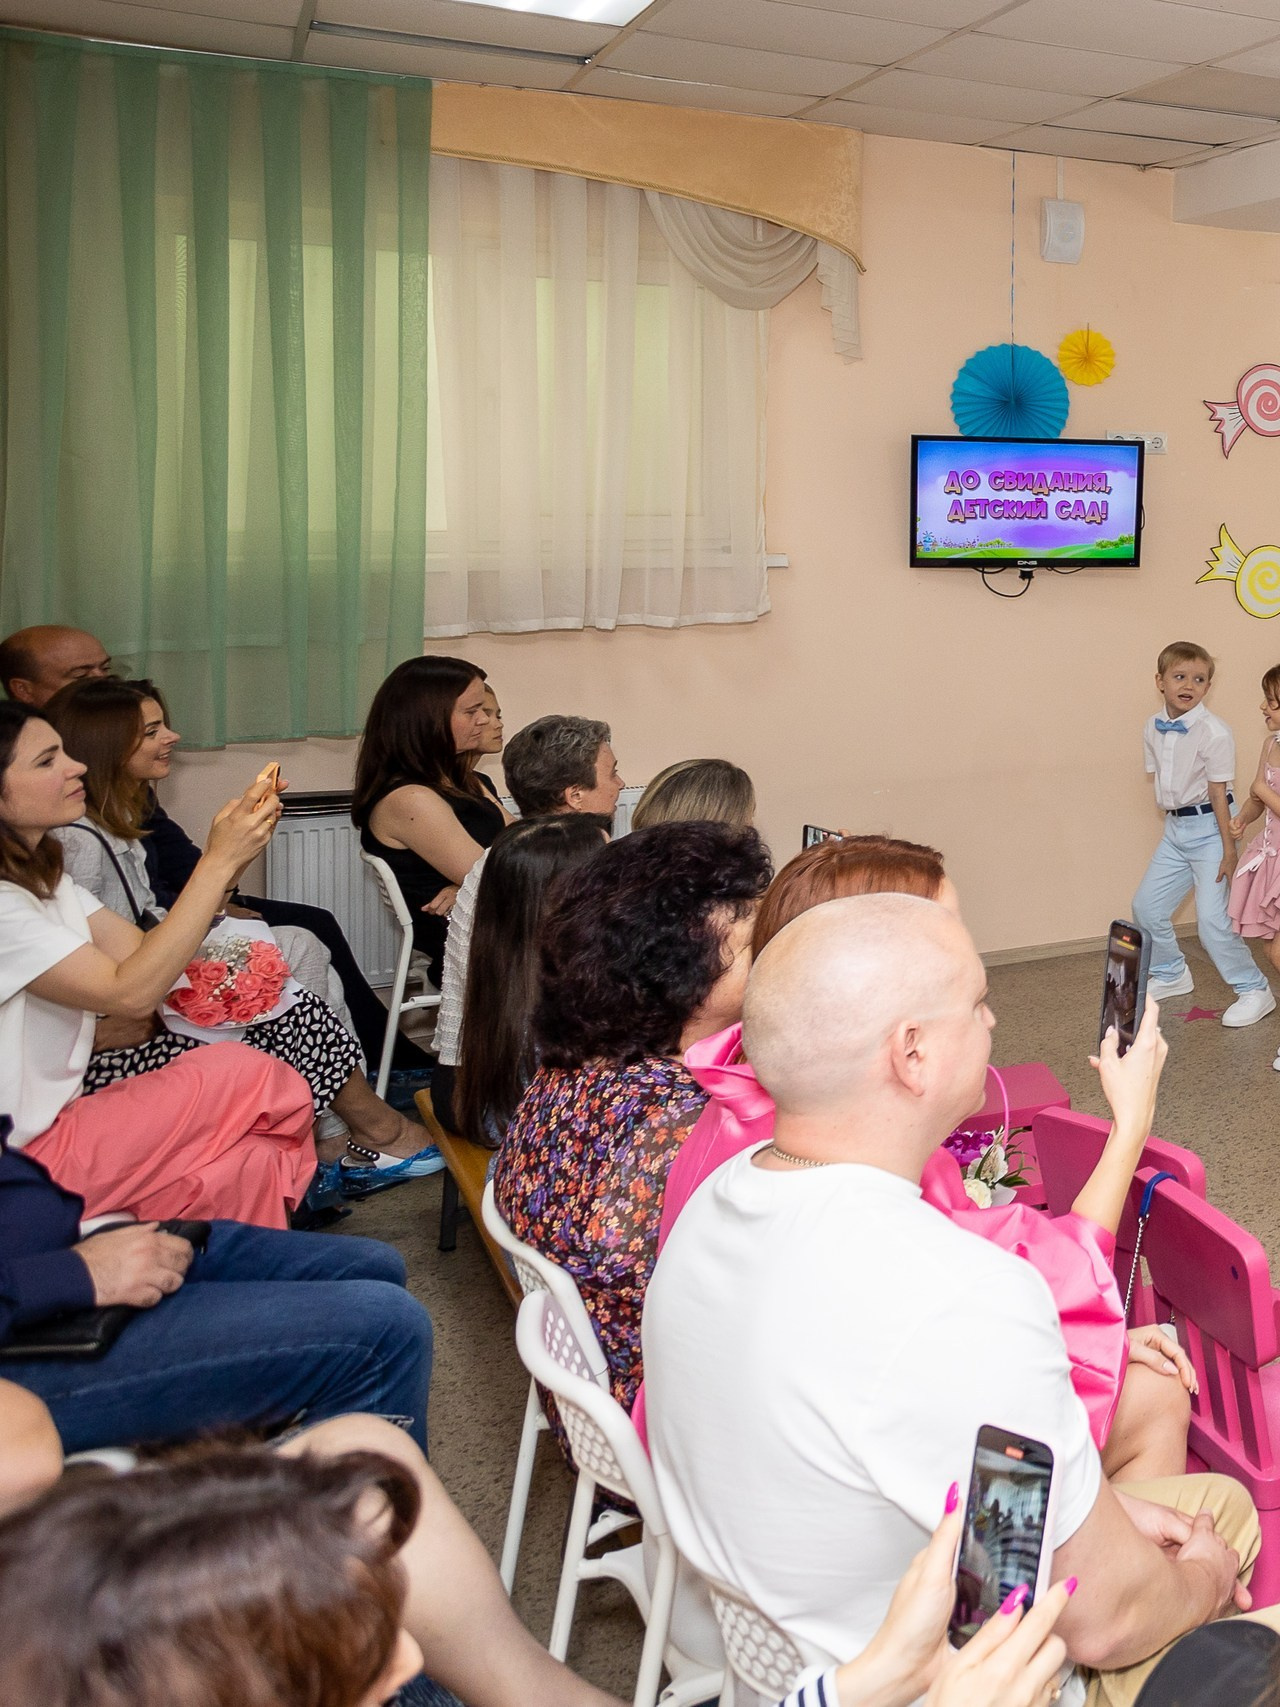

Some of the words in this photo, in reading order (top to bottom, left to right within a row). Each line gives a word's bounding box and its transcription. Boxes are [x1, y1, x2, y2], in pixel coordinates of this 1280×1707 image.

[944, 470, 980, 494] ДО
[989, 471, 1112, 495] СВИДАНИЯ,
[947, 498, 1048, 522] ДЕТСКИЙ
[1055, 500, 1109, 524] САД!
